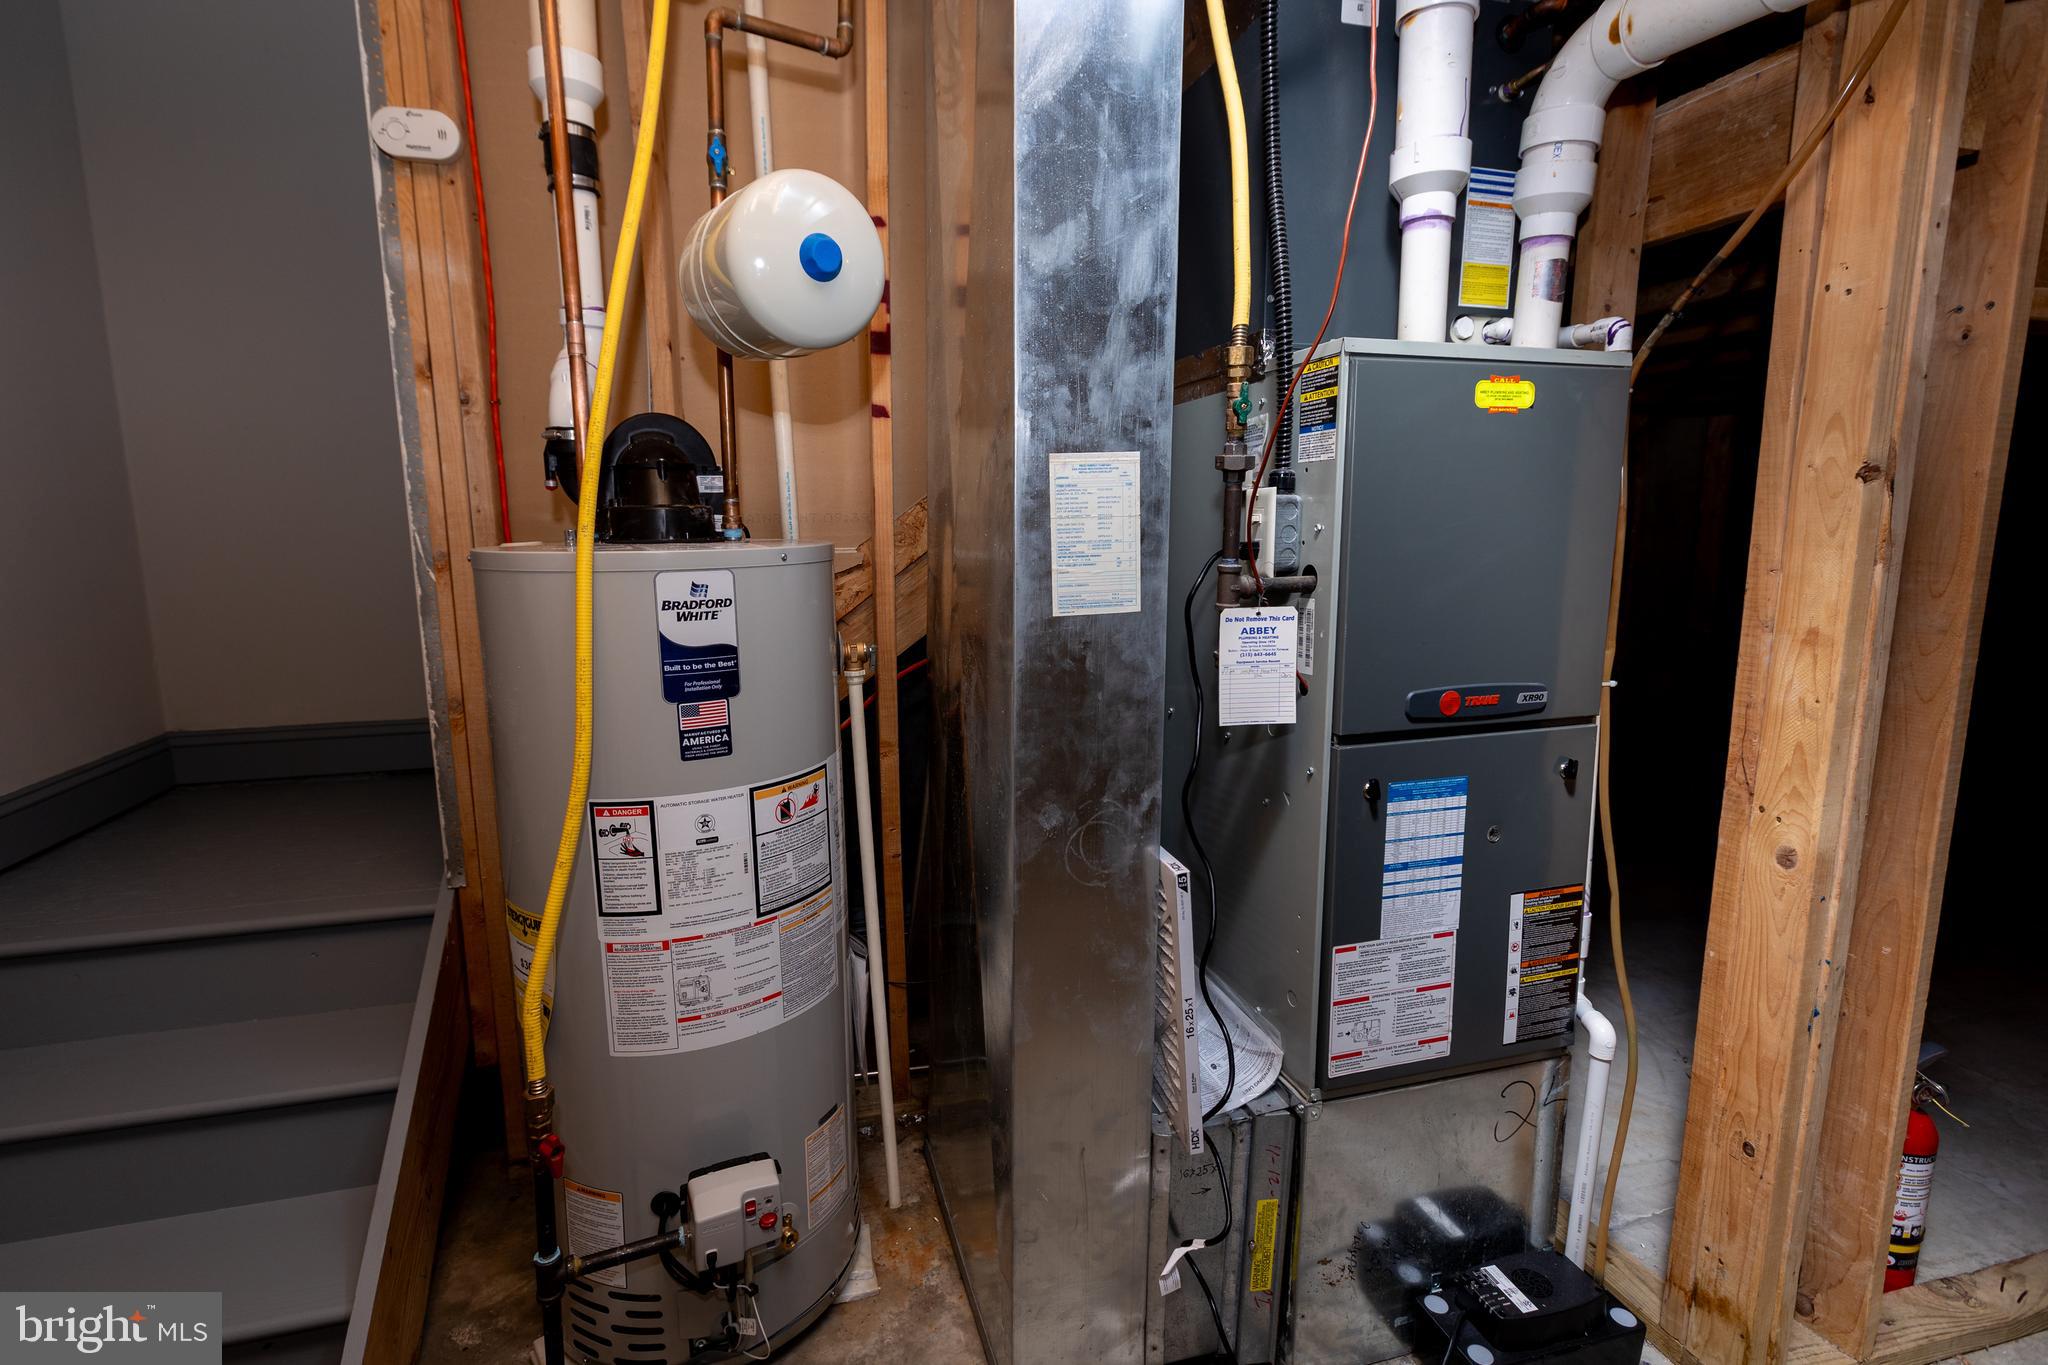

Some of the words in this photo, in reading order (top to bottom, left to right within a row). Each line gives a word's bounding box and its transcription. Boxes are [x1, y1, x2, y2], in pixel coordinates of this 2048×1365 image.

[1308, 387, 1335, 400] ATTENTION
[661, 598, 733, 611] BRADFORD
[676, 610, 719, 622] WHITE
[1240, 626, 1277, 635] ABBEY
[664, 664, 681, 672] Built
[1465, 694, 1500, 707] TRANE
[1521, 693, 1544, 703] XR90
[682, 733, 730, 747] AMERICA
[612, 808, 642, 816] DANGER
[1191, 1128, 1200, 1150] HDX
